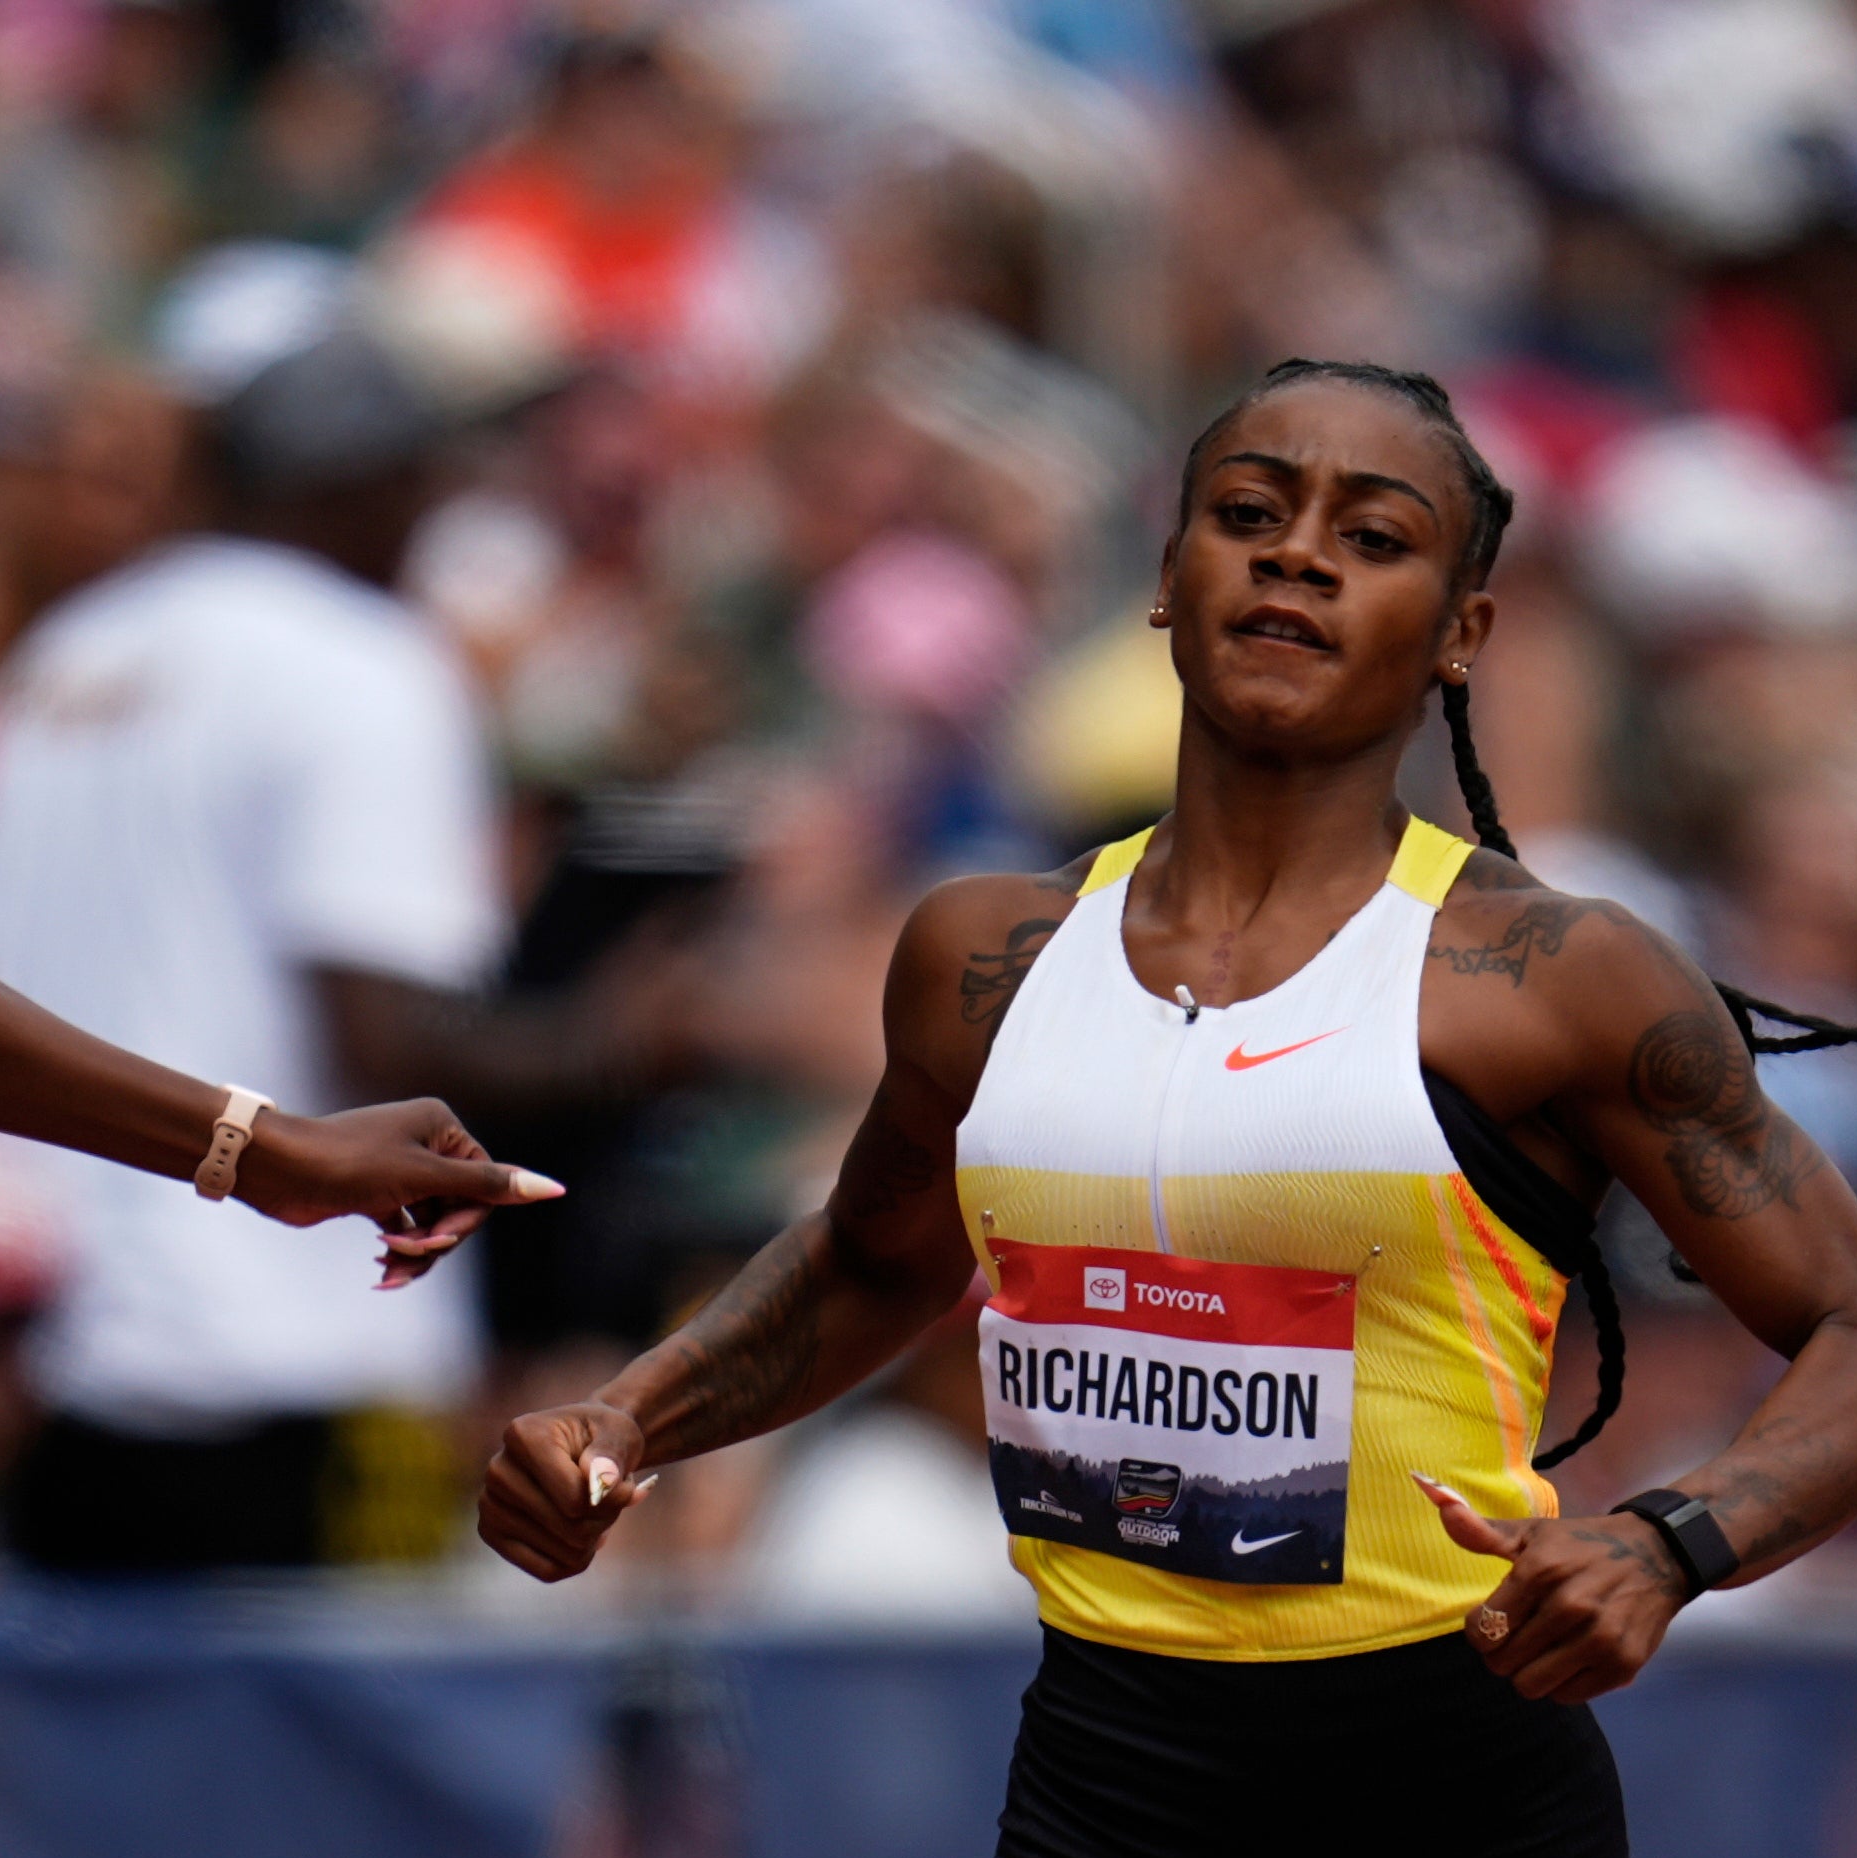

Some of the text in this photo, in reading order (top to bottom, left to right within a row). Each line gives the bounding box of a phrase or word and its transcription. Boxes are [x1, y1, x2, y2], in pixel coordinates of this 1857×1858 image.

[1133, 1282, 1226, 1315] TOYOTA
[998, 1339, 1319, 1440] RICHARDSON
[1117, 1521, 1181, 1543] OUTDOOR
